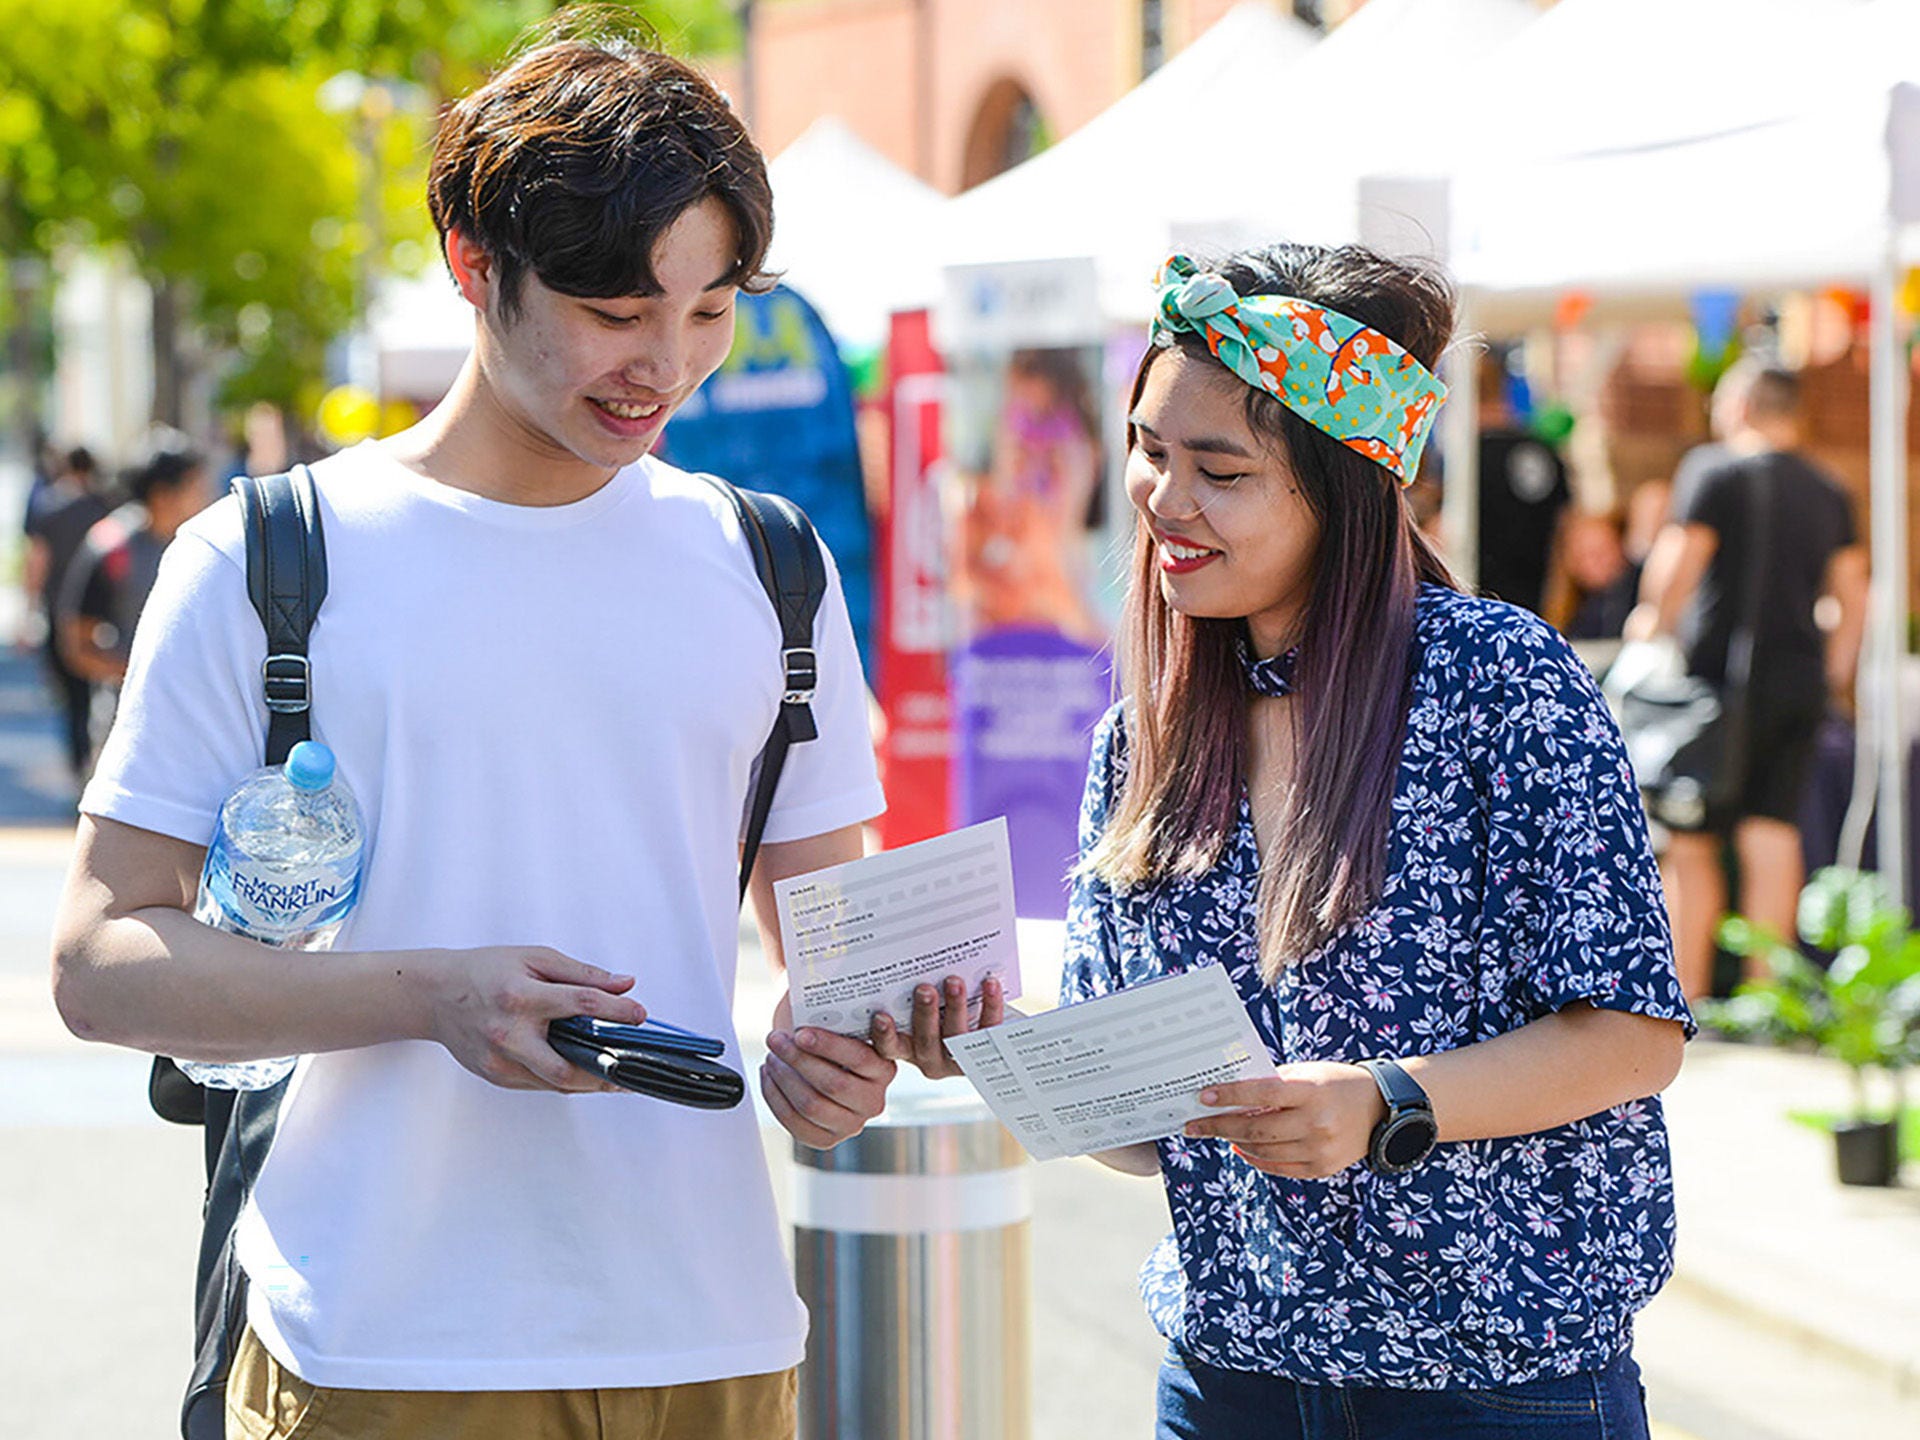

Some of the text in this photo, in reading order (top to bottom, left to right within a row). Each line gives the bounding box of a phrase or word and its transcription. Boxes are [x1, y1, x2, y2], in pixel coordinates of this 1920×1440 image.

[232, 872, 336, 910] FRANKLIN
[252, 876, 320, 897] MOUNT
[789, 885, 816, 896] NAME
[793, 902, 835, 917] STUDENT
[796, 912, 875, 937] MOBILE NUMBER
[798, 932, 874, 956] EMAIL ADDRESS
[870, 964, 897, 974] WANT
[899, 958, 913, 966] TO
[915, 941, 971, 961] VOLUNTEER
[1008, 1028, 1034, 1038] NAME
[964, 1040, 991, 1049] NAME
[1017, 1041, 1059, 1055] STUDENT
[1027, 1048, 1104, 1071] MOBILE NUMBER
[1035, 1064, 1111, 1086] EMAIL ADDRESS
[1119, 1088, 1146, 1097] WANT
[1164, 1066, 1221, 1085] VOLUNTEER
